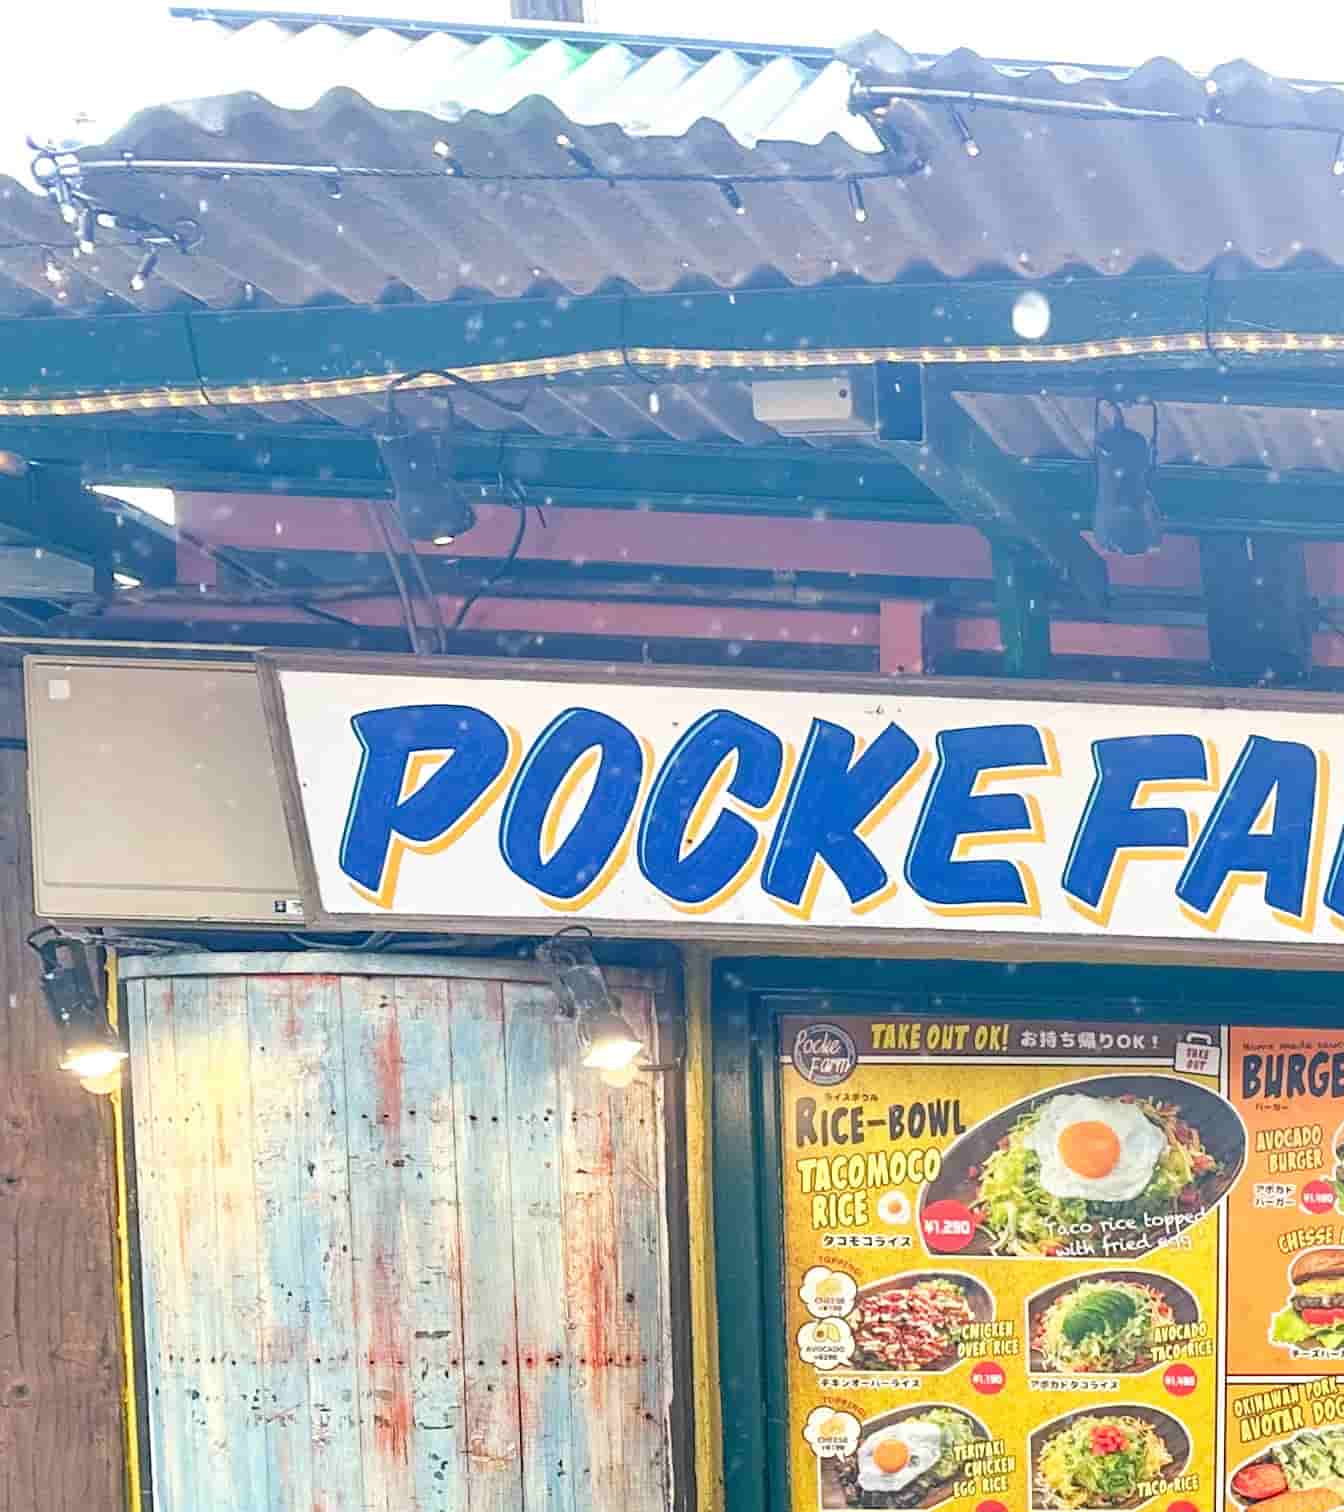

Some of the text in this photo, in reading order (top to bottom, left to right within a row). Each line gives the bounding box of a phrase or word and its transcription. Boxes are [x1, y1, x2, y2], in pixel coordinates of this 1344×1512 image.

[339, 704, 1061, 921] POCKE
[871, 1022, 1009, 1052] TAKE OUT OK!
[1256, 1124, 1322, 1152] AVOCADO
[797, 1147, 943, 1194] TACOMOCO
[1268, 1150, 1324, 1173] BURGER
[811, 1190, 870, 1230] RICE
[1041, 1206, 1207, 1236] Taco rice topped
[822, 1233, 913, 1249] タコモコライス
[1056, 1240, 1095, 1257] with
[1102, 1234, 1153, 1256] fried
[960, 1319, 1016, 1340] CHICKEN
[1153, 1322, 1208, 1343] AVOCADO
[957, 1338, 1020, 1359] OVER RICE
[1232, 1376, 1340, 1418] OKINAWAN PORK
[953, 1439, 1007, 1462] TERIYAKI
[963, 1455, 1017, 1478] CHICKEN
[952, 1475, 1010, 1498] EGG RICE
